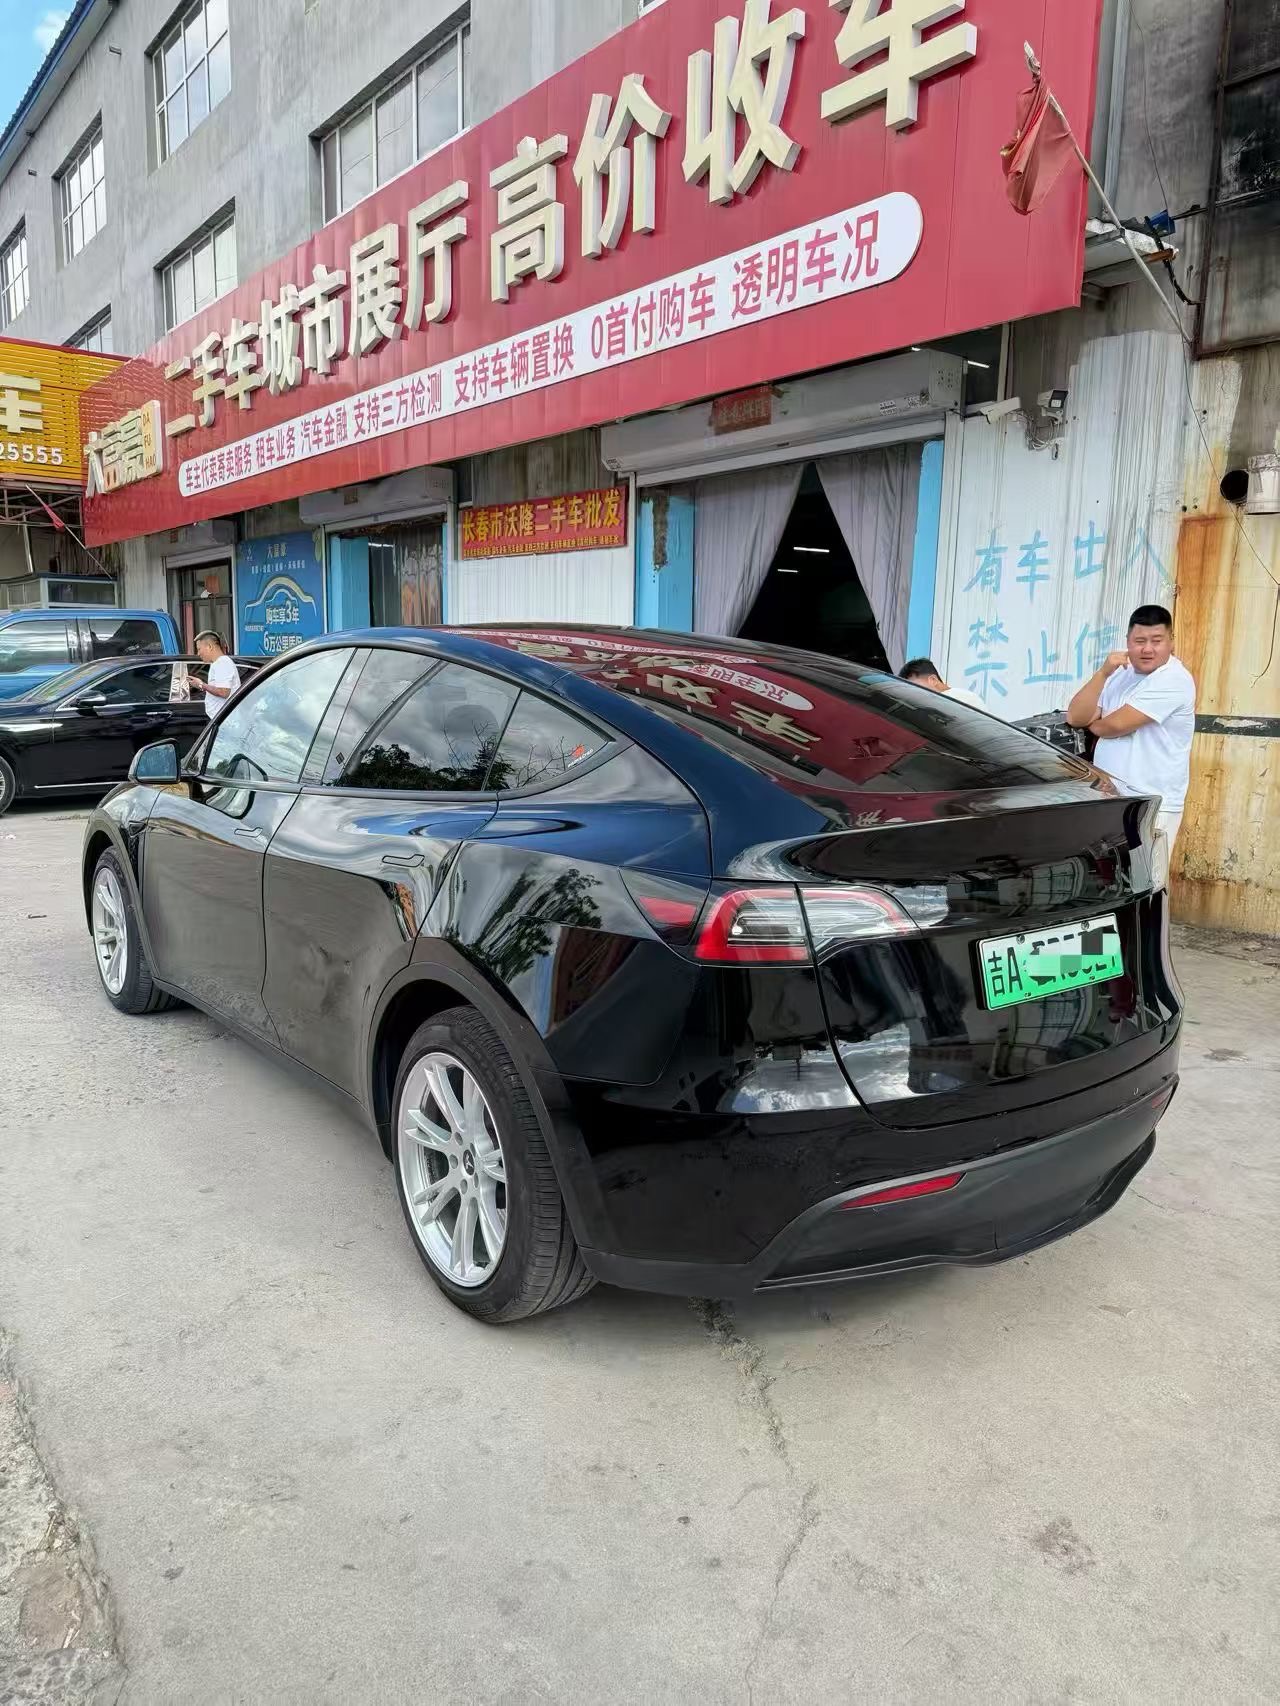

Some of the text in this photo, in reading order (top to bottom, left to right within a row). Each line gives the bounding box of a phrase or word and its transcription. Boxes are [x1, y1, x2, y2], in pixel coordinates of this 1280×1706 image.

[164, 0, 978, 437] 二手车城市展厅 高价收车
[185, 210, 880, 493] 车主代卖寄卖服务 租车业务 汽车金融 支持三方检测 支持车辆置换 0首付购车 透明车况
[463, 488, 621, 544] 长春市沃隆二手车批发
[962, 519, 1176, 604] 有车出入
